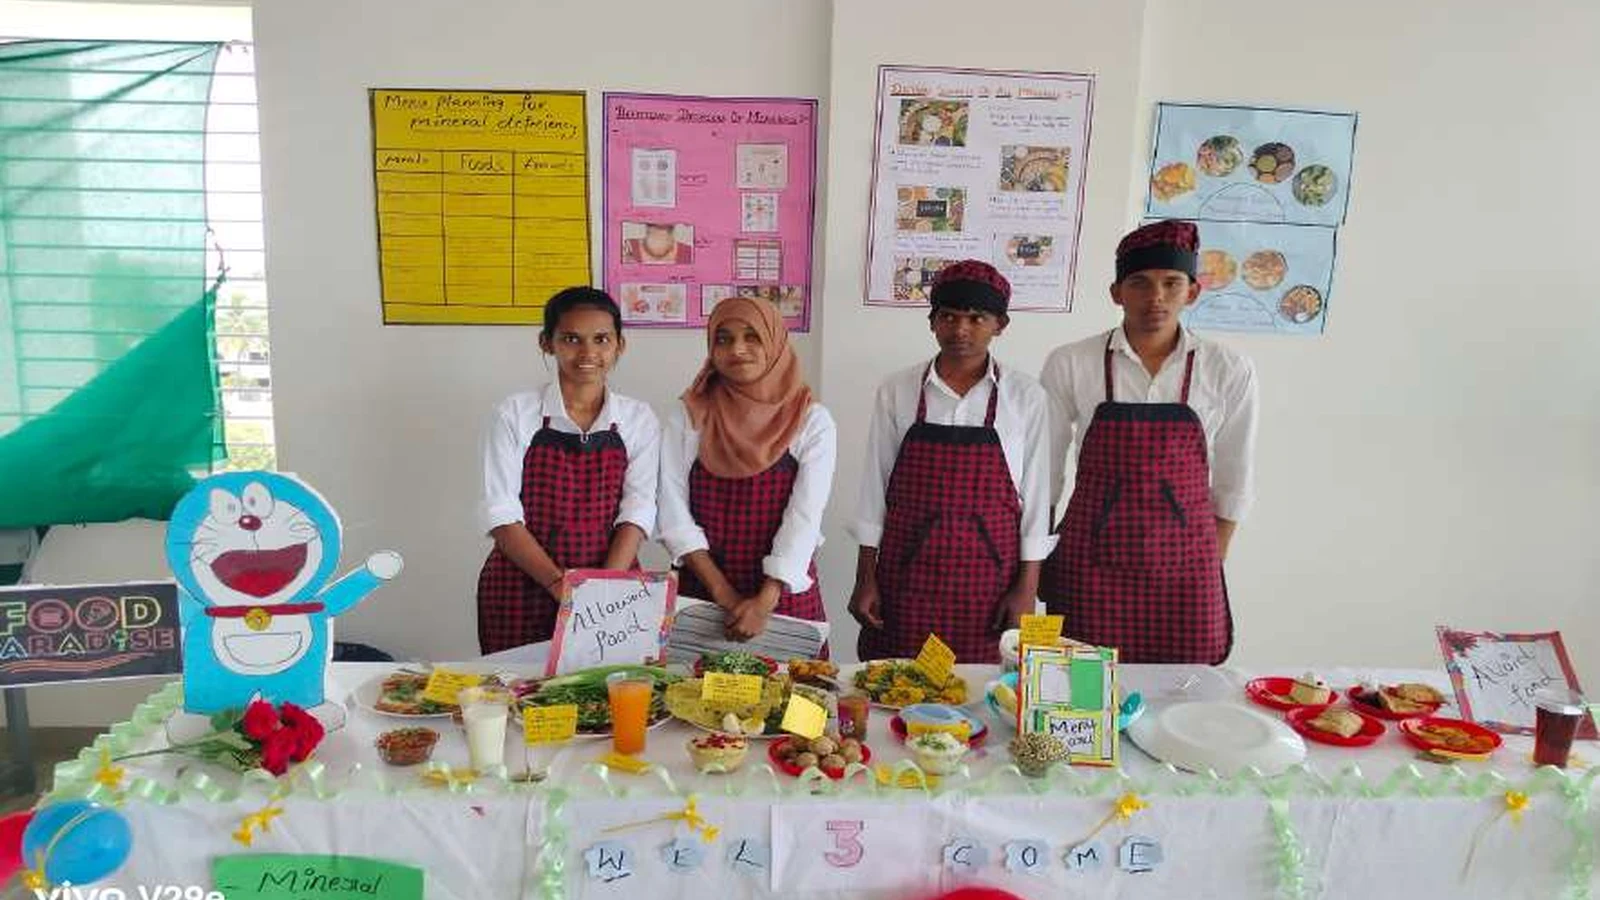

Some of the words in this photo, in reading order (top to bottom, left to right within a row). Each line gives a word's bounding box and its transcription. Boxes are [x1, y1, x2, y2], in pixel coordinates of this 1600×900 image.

[0, 596, 162, 636] FOOD
[0, 627, 175, 659] ARADISE
[824, 820, 865, 868] 3
